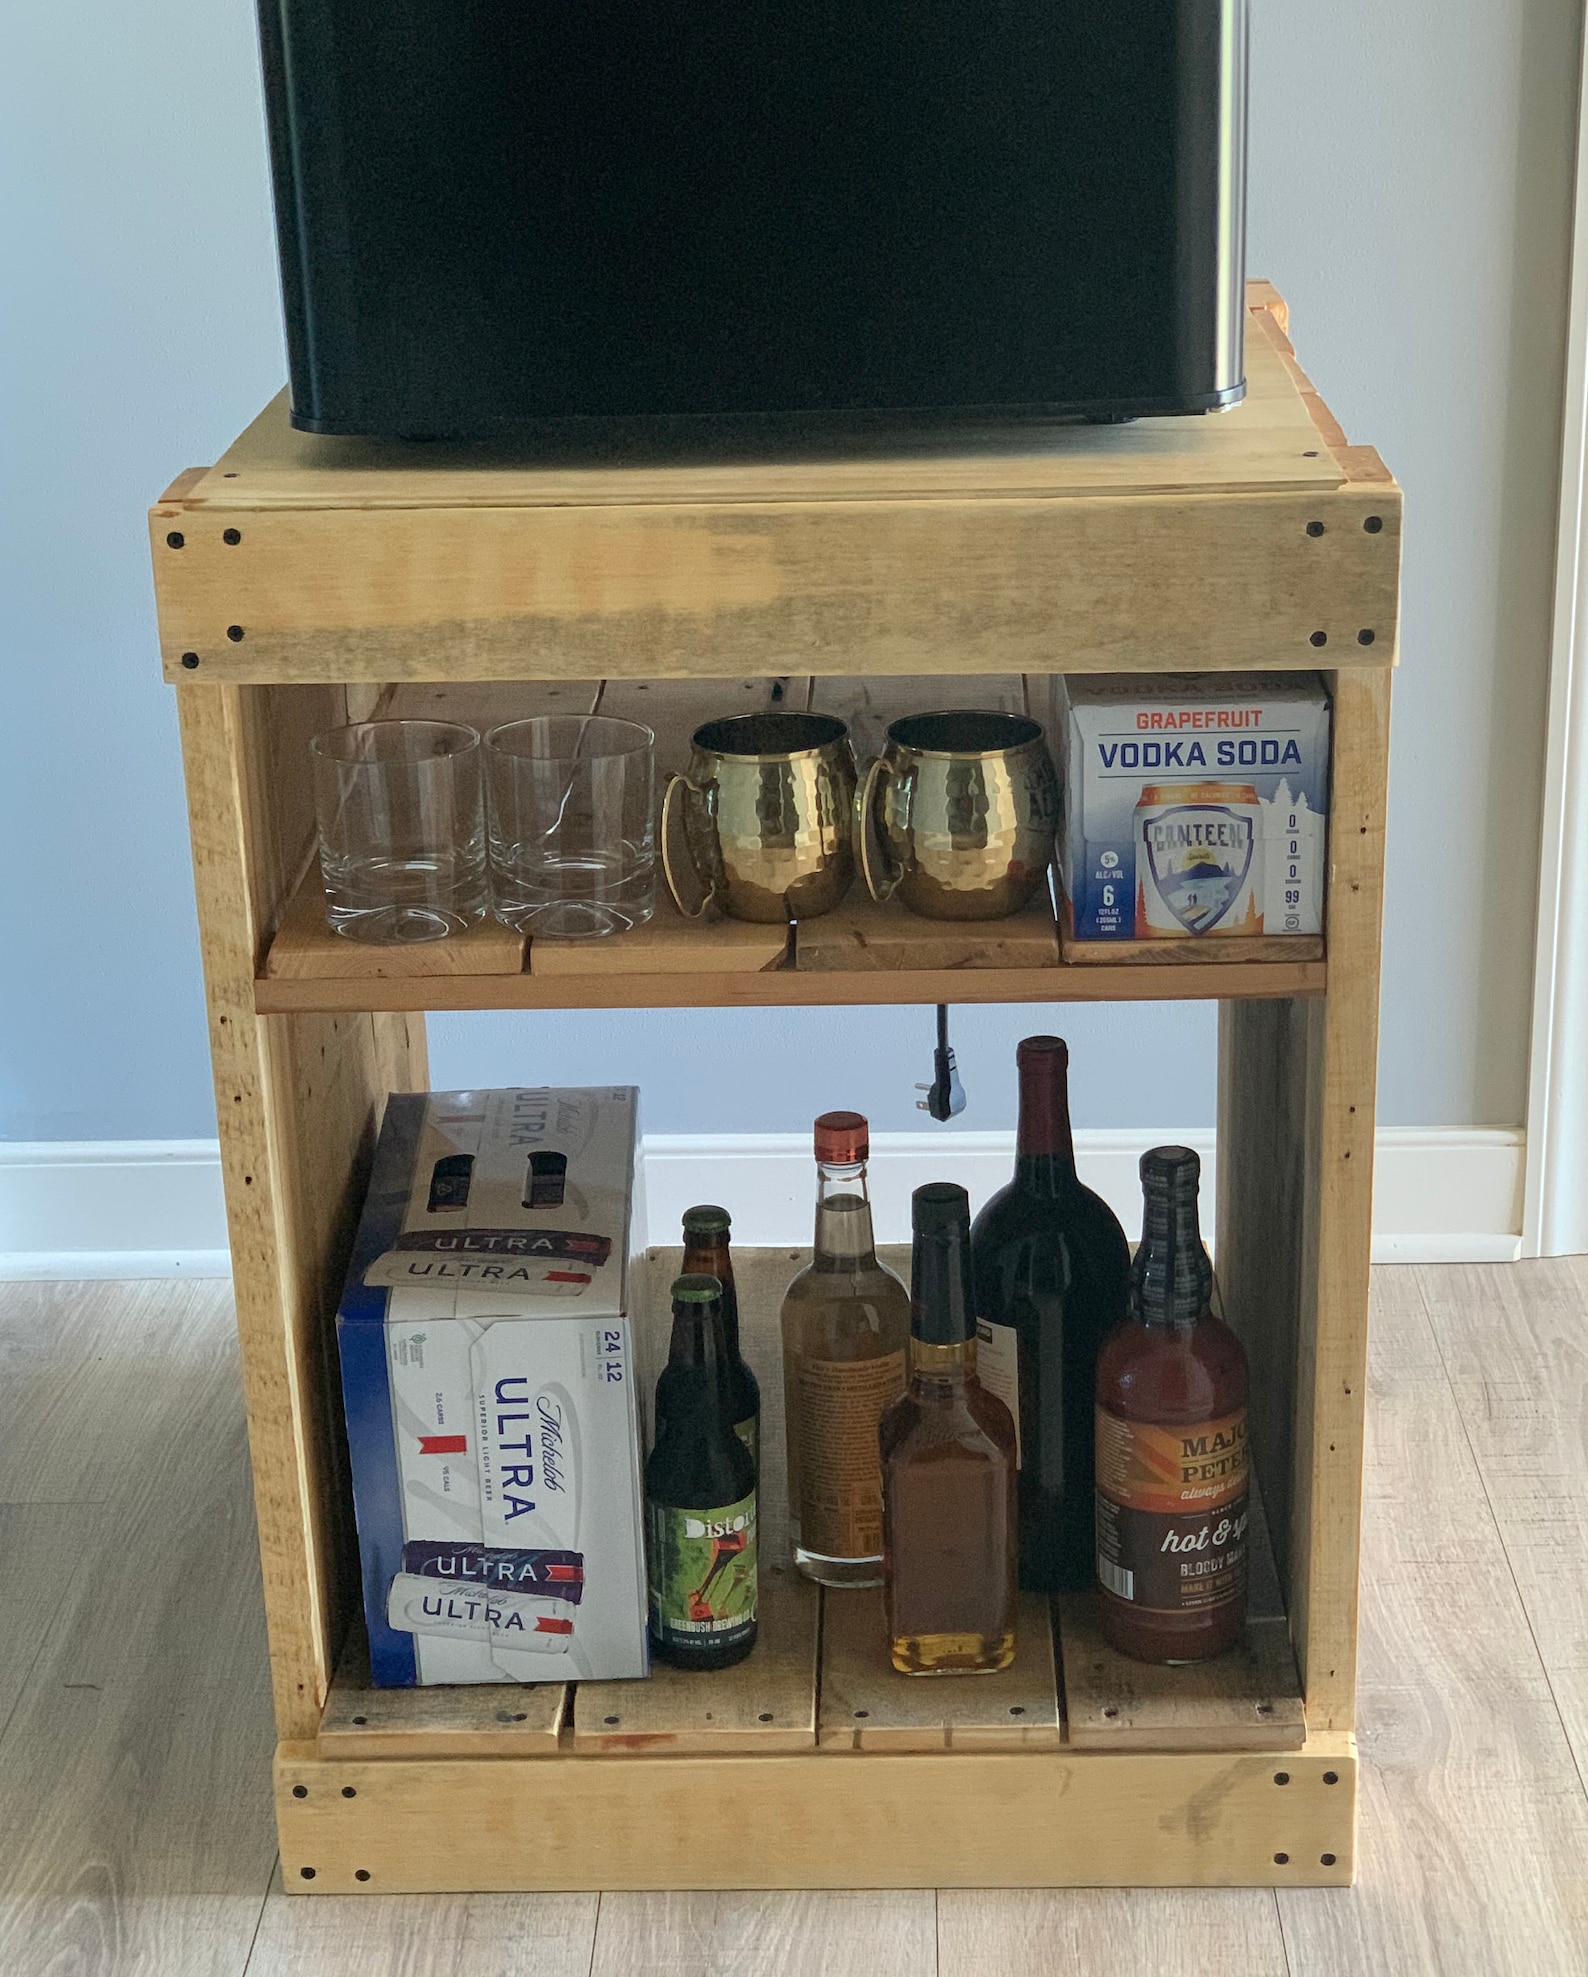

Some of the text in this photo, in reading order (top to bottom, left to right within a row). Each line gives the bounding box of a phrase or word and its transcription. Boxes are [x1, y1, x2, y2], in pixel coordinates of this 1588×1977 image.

[1136, 710, 1263, 730] GRAPEFRUIT
[1098, 739, 1302, 768] VODKA SODA
[1289, 814, 1296, 828] 0
[1153, 823, 1243, 852] CANTEEN
[1290, 840, 1297, 854] 0
[1095, 869, 1124, 879] ALC/VOL
[1289, 864, 1297, 878] 0
[1103, 884, 1115, 907] 6
[1285, 890, 1300, 904] 99
[508, 1091, 549, 1147] ULTRA
[434, 1236, 554, 1250] ULTRA
[407, 1262, 530, 1281] ULTRA
[604, 1330, 622, 1383] 24 12
[435, 1392, 445, 1425] 2.6 CARBS
[478, 1394, 493, 1502] SUPERIOR LIGHT BEER
[494, 1377, 537, 1521] ULTRA
[536, 1396, 566, 1494] Michelob
[442, 1465, 451, 1492] 95 CALS
[1180, 1482, 1226, 1500] always
[1161, 1526, 1209, 1553] hot
[1211, 1518, 1231, 1546] &
[436, 1555, 538, 1582] ULTRA
[1180, 1557, 1224, 1577] BLOODY
[422, 1595, 526, 1631] ULTRA
